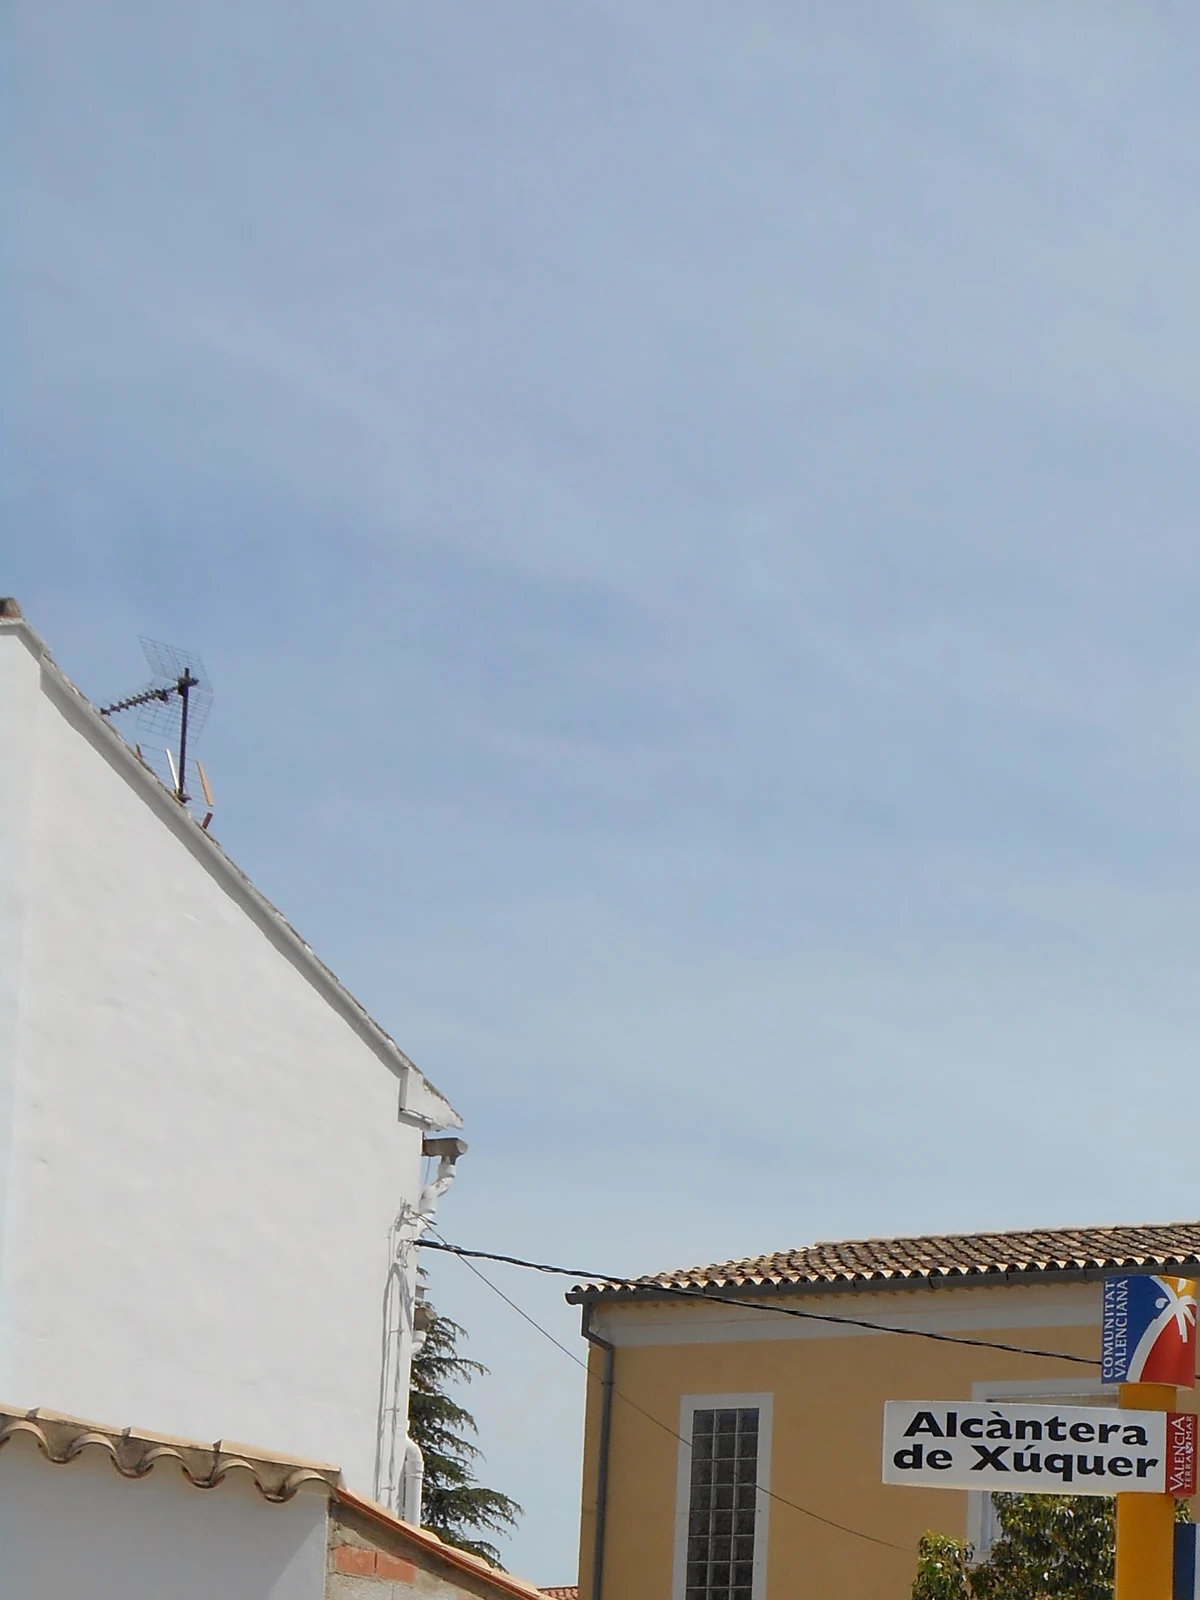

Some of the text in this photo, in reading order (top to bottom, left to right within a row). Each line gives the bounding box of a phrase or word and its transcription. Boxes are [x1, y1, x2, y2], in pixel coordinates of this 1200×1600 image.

[1103, 1281, 1115, 1378] COMUNITAT
[1114, 1280, 1128, 1378] VALENCIANA
[893, 1444, 1160, 1483] de Xúquer
[903, 1411, 1149, 1447] Alcàntera
[1169, 1416, 1186, 1491] VALENCIA
[1184, 1415, 1194, 1490] TERRA MAR
